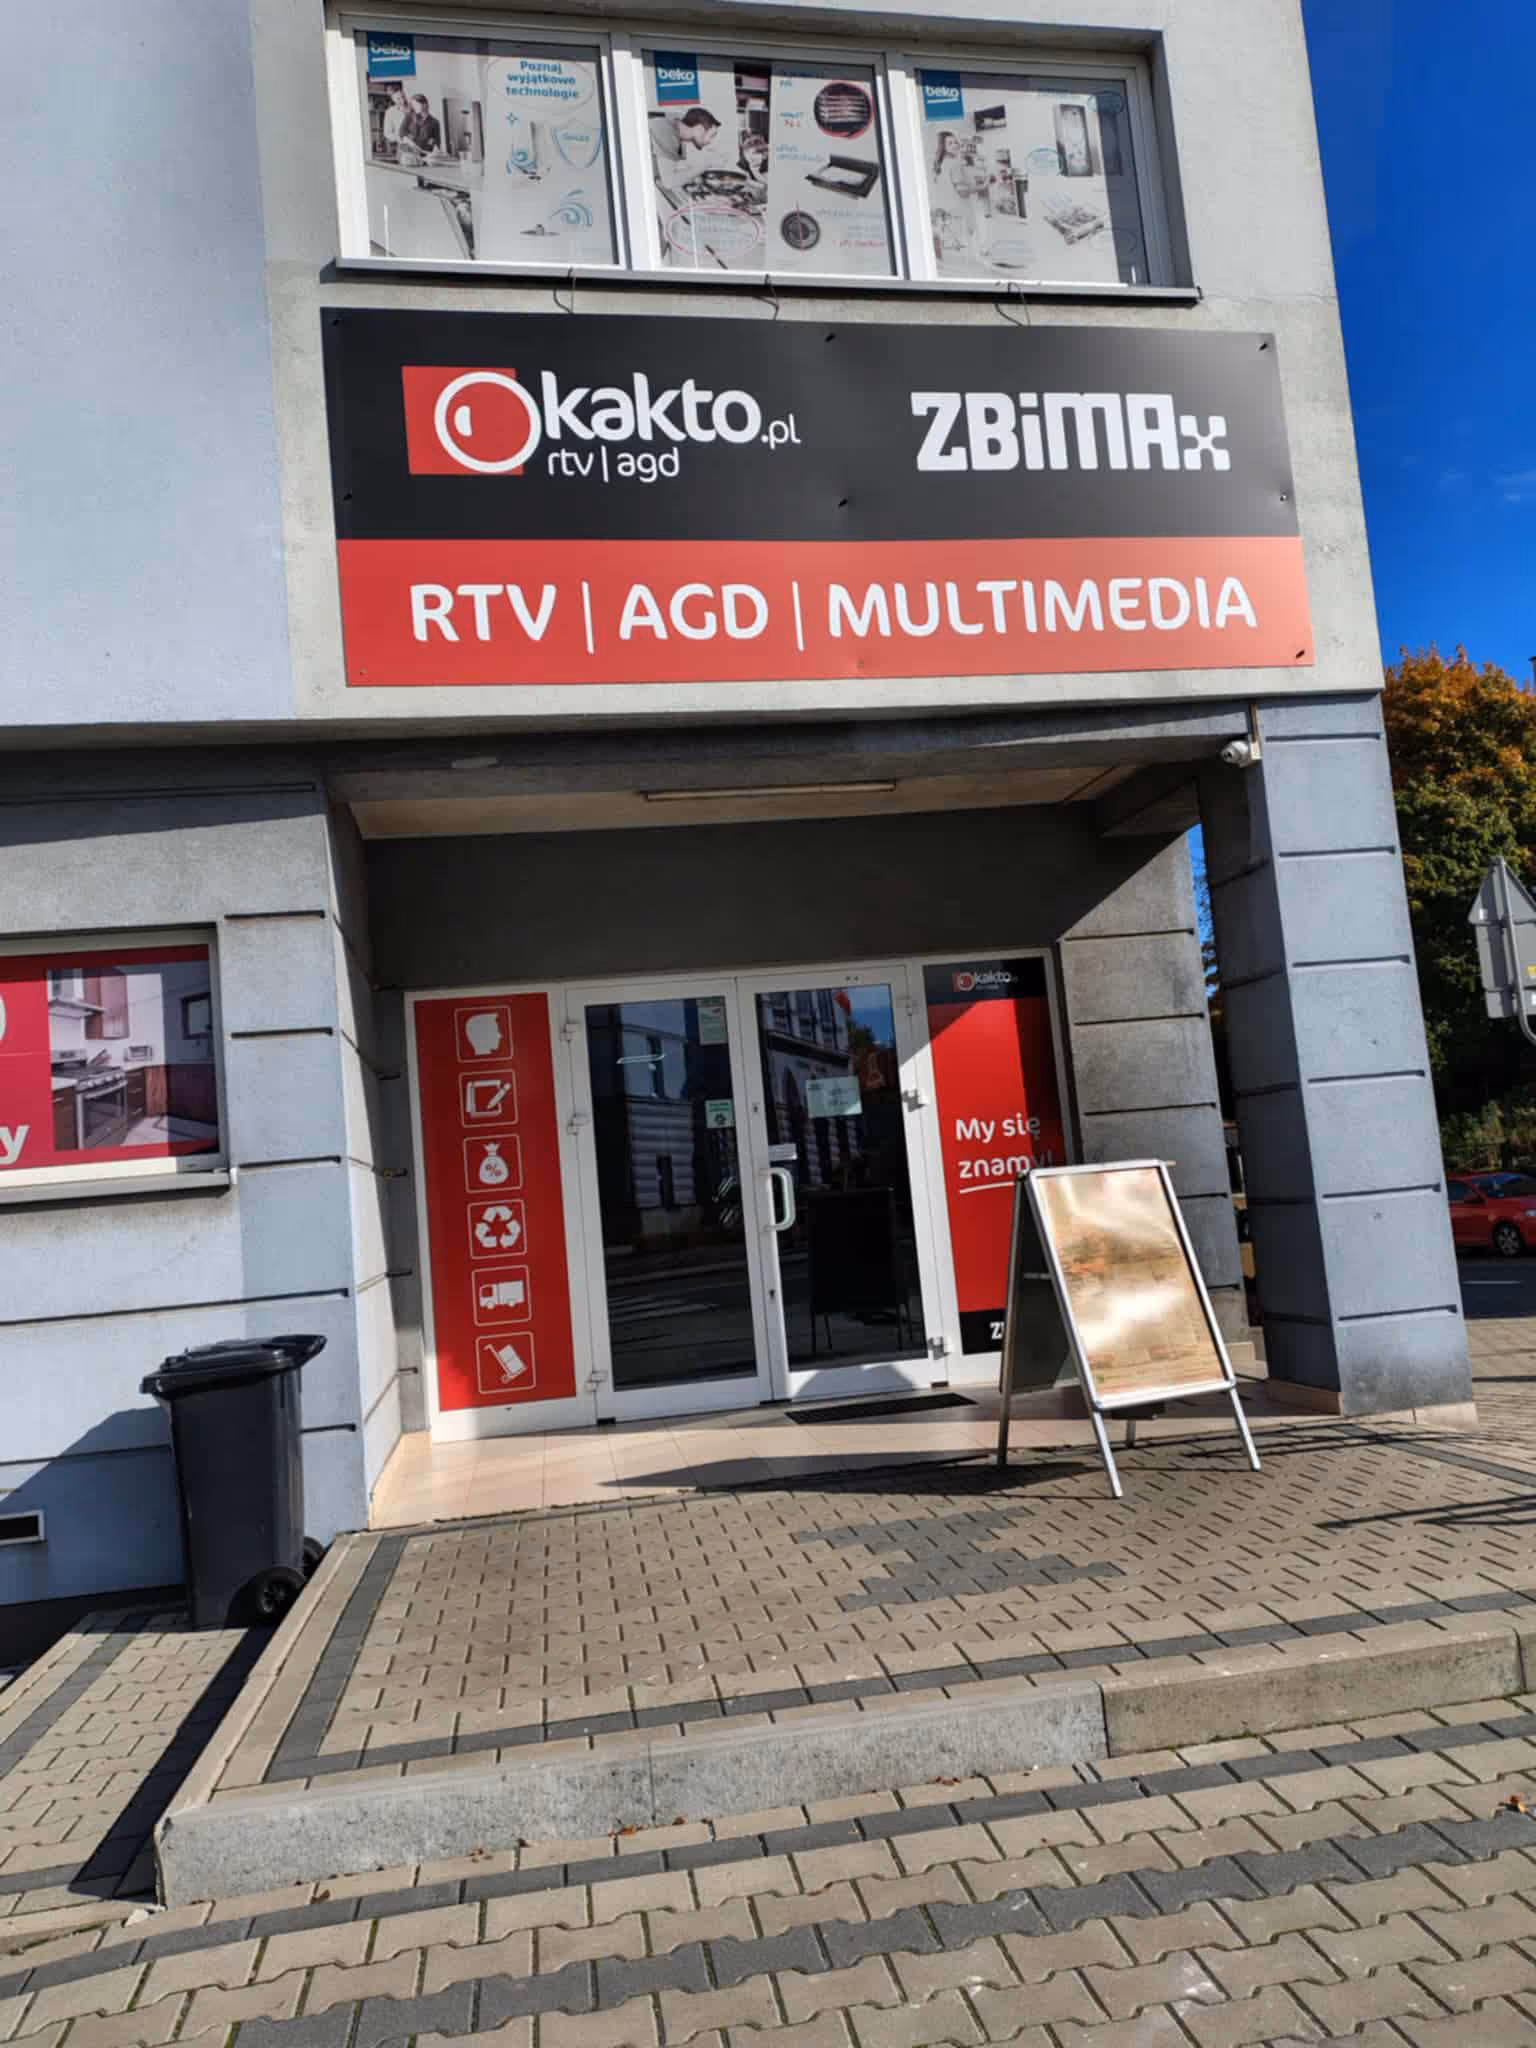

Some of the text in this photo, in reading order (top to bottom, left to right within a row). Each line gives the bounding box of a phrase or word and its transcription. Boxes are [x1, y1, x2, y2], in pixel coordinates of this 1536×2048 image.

[519, 60, 563, 74] Poznaj
[656, 67, 696, 82] beko
[506, 70, 577, 86] wyjątkowe
[505, 84, 580, 100] technologie
[925, 84, 960, 98] beko
[410, 576, 1258, 642] RTV AGD MULTIMEDIA
[955, 1112, 1041, 1144] My się
